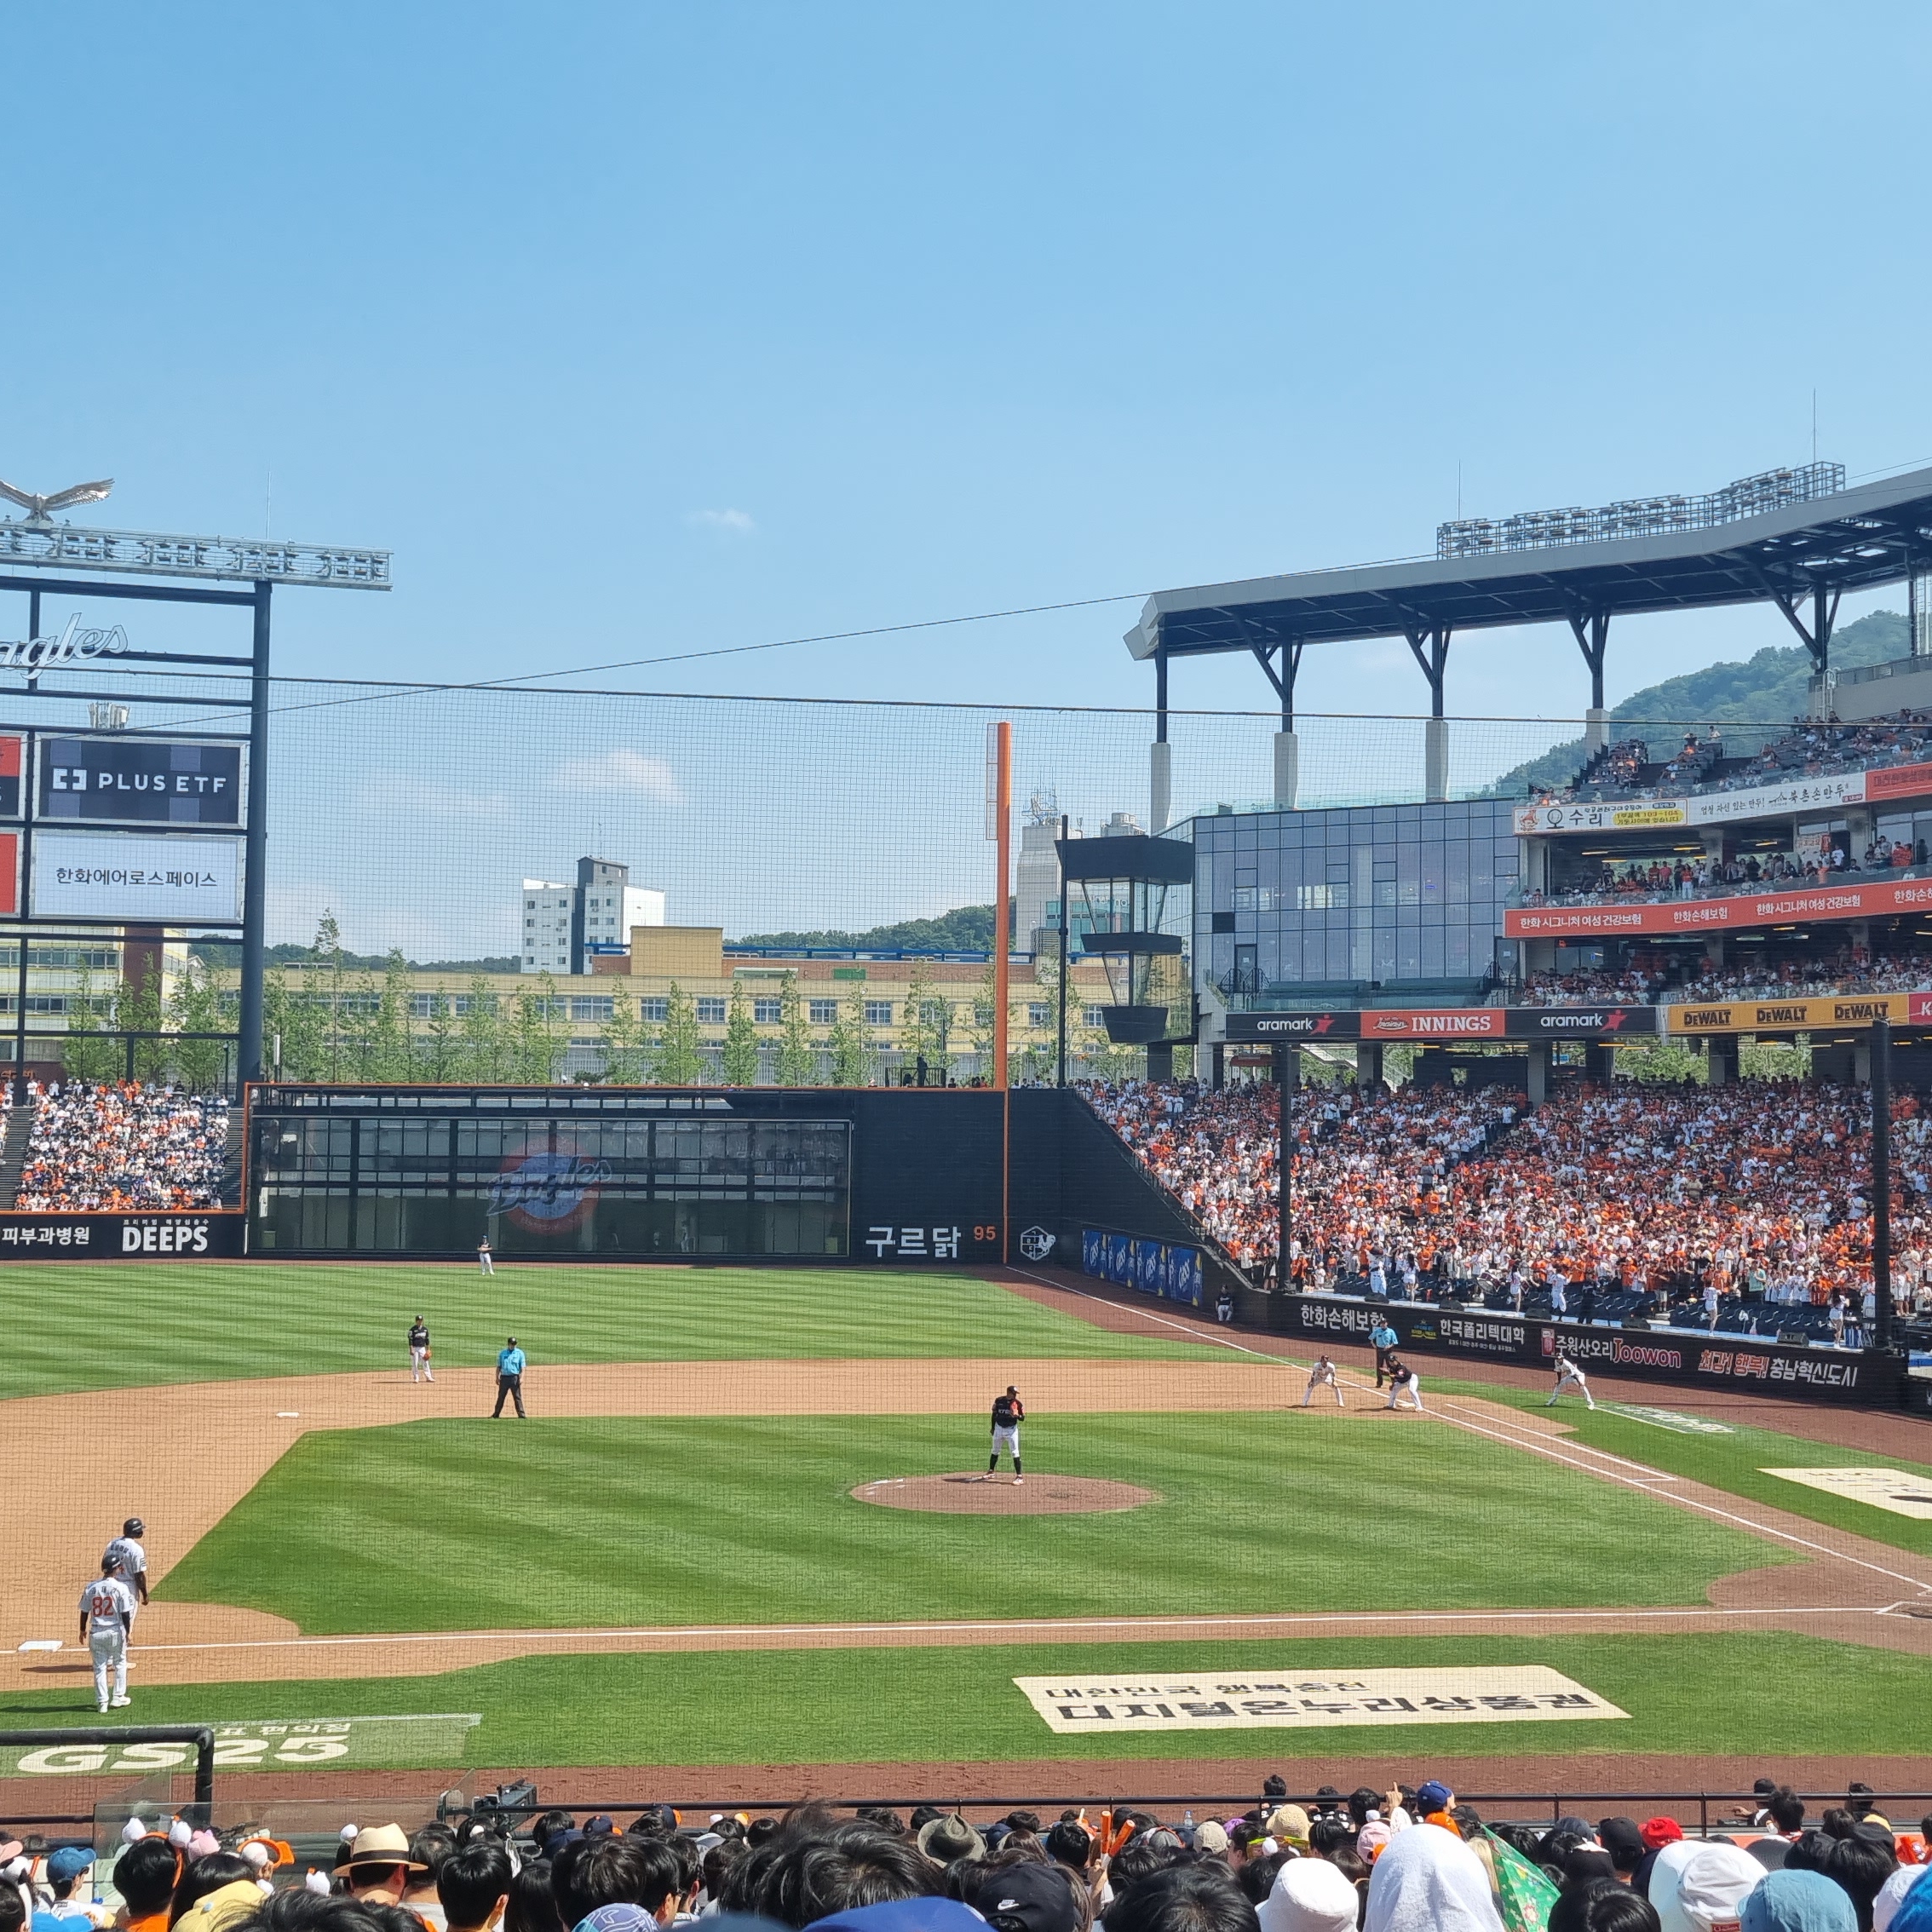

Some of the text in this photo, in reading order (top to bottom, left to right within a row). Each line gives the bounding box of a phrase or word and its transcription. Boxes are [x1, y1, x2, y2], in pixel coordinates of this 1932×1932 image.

[99, 773, 227, 793] PLUS ETF
[1788, 784, 1844, 803] 북촌손만두
[55, 866, 218, 888] 한화에어로스페이스
[1673, 906, 1728, 923] 한화손해보험
[1756, 894, 1860, 916] 한화 시그니처 여성 건강보험
[1521, 913, 1642, 929] 한화 시그니처 여성 건강보험
[1256, 1017, 1314, 1032] aramark
[1412, 1015, 1491, 1032] INNINGS
[1540, 1013, 1603, 1028] aramark
[2, 1227, 89, 1245] 피부과병원
[122, 1226, 209, 1251] DEEPS
[865, 1226, 962, 1258] 구르닭
[974, 1225, 997, 1240] 95
[1440, 1319, 1525, 1345] 한국폴리텍대학
[1555, 1335, 1613, 1361] 주원산오리
[1613, 1337, 1682, 1369] Joowon
[1769, 1357, 1859, 1388] 충남혁신도시
[92, 1596, 114, 1618] 82
[1045, 1685, 1202, 1698] 대한민국
[1055, 1693, 1600, 1720] 디지털온누리상품권
[259, 1722, 352, 1736] 편의점
[17, 1734, 350, 1774] GS25
